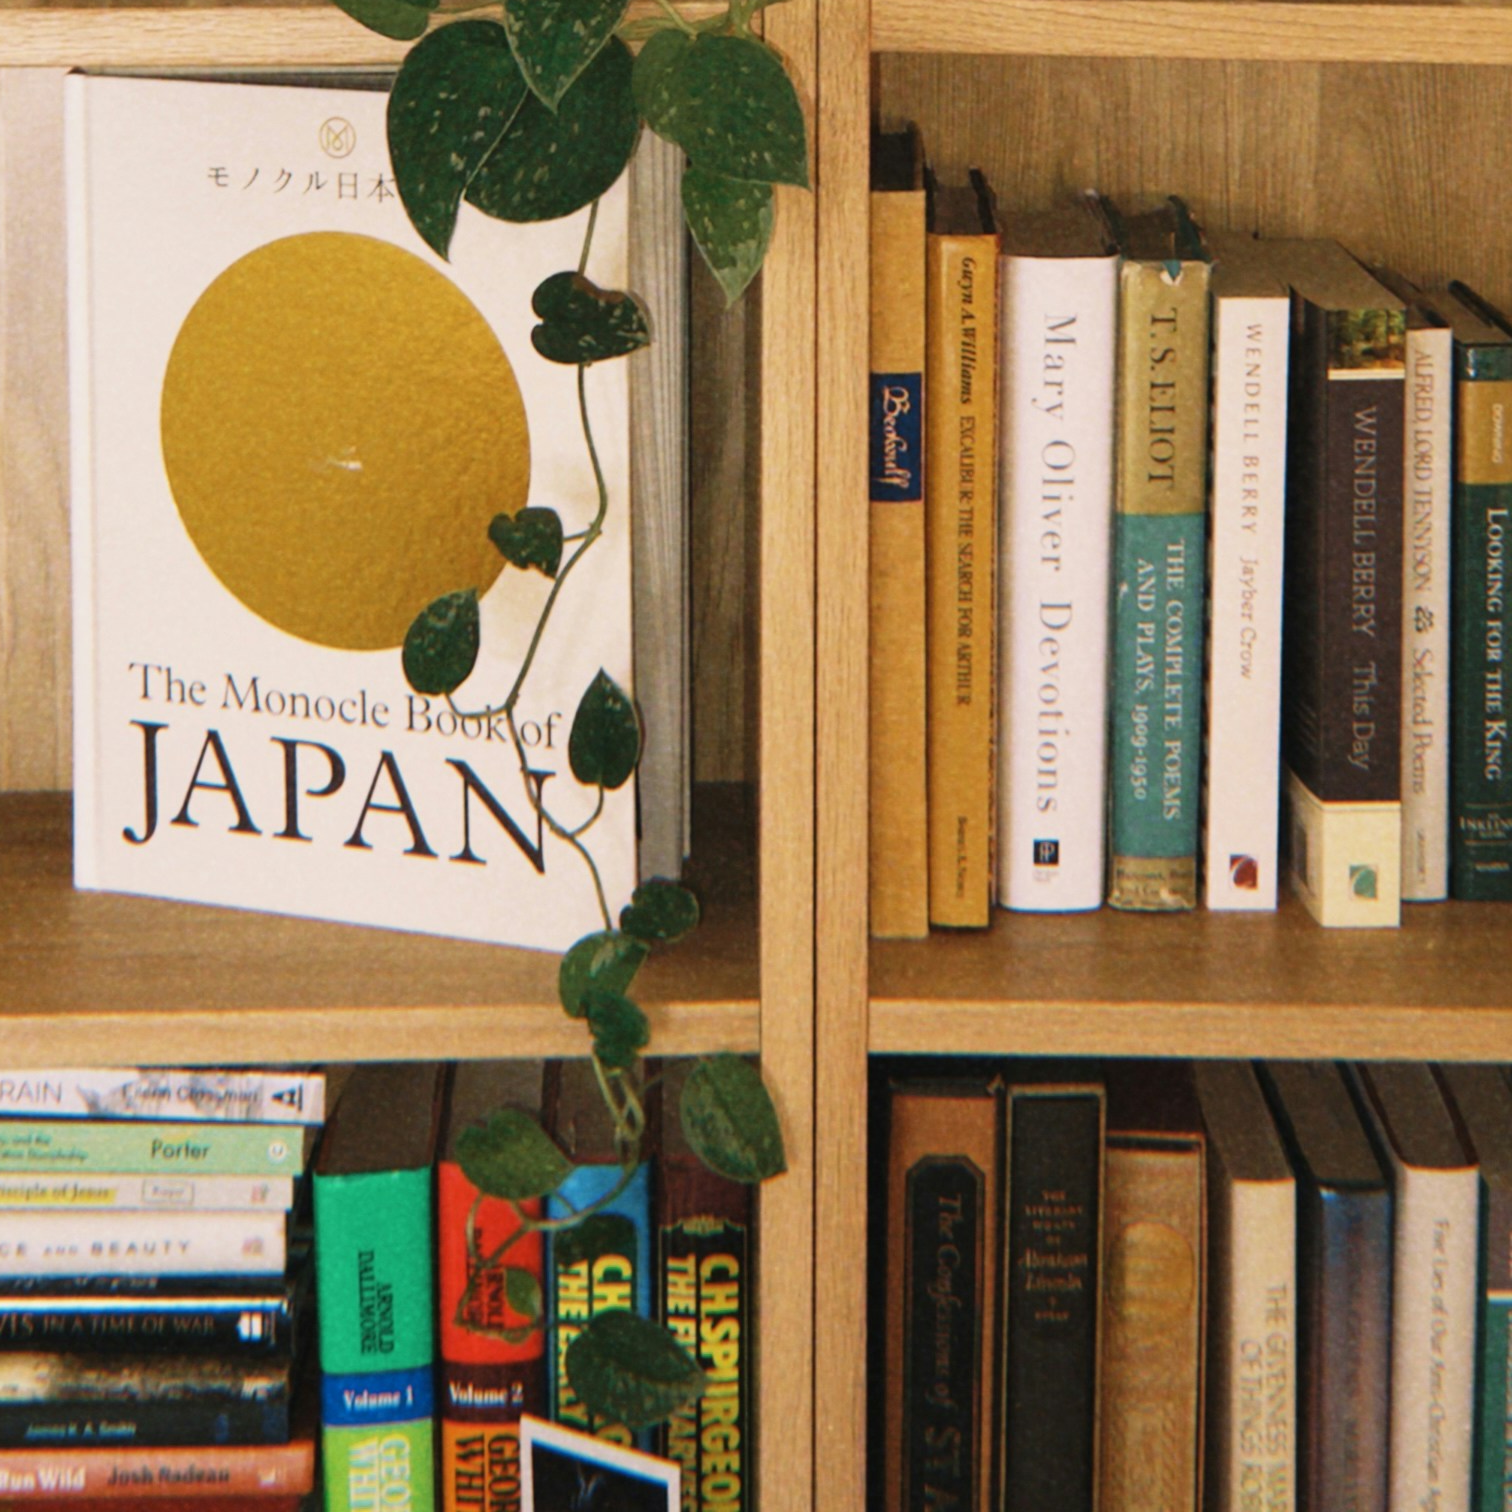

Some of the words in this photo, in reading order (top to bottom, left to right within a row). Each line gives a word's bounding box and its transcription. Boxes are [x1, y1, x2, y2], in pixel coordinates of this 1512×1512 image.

[206, 164, 396, 204] モノクル日本
[1152, 307, 1176, 338] T.
[1032, 314, 1076, 420] Mary
[1151, 345, 1174, 373] S.
[960, 415, 974, 503] EXCALIBUR:
[1147, 379, 1175, 490] ELIOT
[959, 507, 973, 539] THE
[1041, 441, 1074, 571] Oliver
[958, 543, 973, 603] SEARCH
[1138, 558, 1155, 612] AND
[1167, 539, 1185, 592] THE
[1486, 508, 1509, 614] LOOKING
[957, 607, 973, 638] FOR
[1486, 619, 1503, 662] FOR
[956, 641, 971, 707] ARTHUR
[1136, 621, 1154, 696] PLAYS,
[1166, 598, 1184, 731] COMPLETE
[128, 661, 207, 710] The
[220, 673, 390, 728] Monocle
[405, 692, 505, 742] Book
[520, 711, 563, 747] of
[1036, 599, 1071, 813] Devotions
[1486, 669, 1503, 714] THE
[1132, 703, 1149, 801] 1909-1950
[1164, 739, 1182, 820] POEMS
[1485, 718, 1507, 782] KING
[122, 719, 558, 875] JAPAN
[0, 1081, 62, 1103] RAIN
[343, 1391, 400, 1410] Volume
[405, 1387, 413, 1404] 1
[449, 1386, 504, 1406] Volume
[511, 1385, 523, 1402] 2
[38, 1467, 86, 1490] Wild
